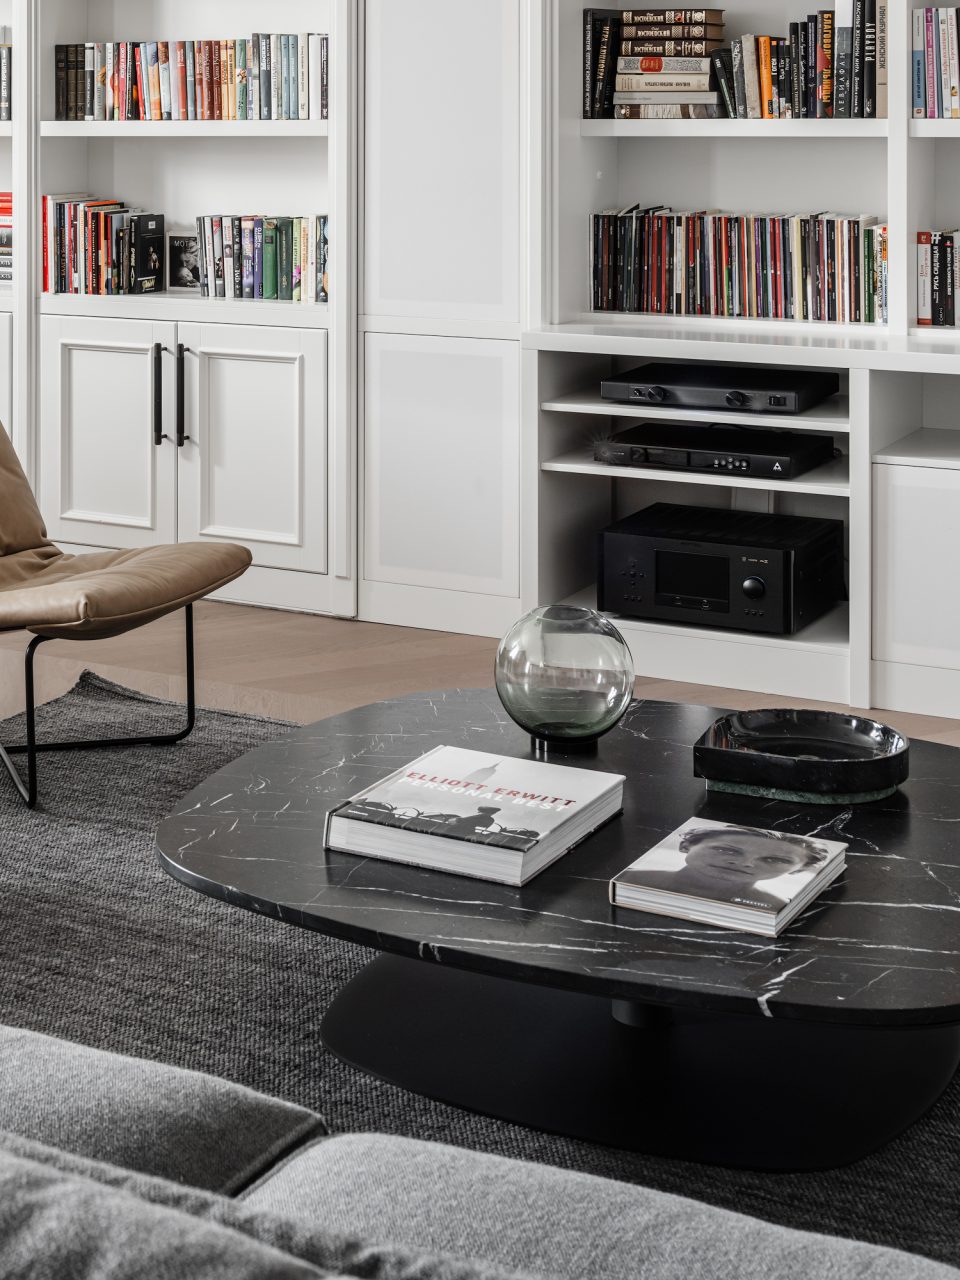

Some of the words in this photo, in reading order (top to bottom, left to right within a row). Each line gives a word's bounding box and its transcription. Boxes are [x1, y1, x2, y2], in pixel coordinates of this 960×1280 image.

[601, 26, 610, 42] ИГРА
[878, 6, 886, 35] ЖУРНАЛ
[865, 22, 876, 62] PLAYBOY
[878, 35, 886, 69] ЖЕНСКИЙ
[838, 51, 846, 113] ЛЕВИАФАН
[397, 778, 509, 803] PERSONAL
[510, 797, 567, 813] BEST
[404, 771, 488, 793] ELLIOTT
[494, 785, 577, 807] ERWITT
